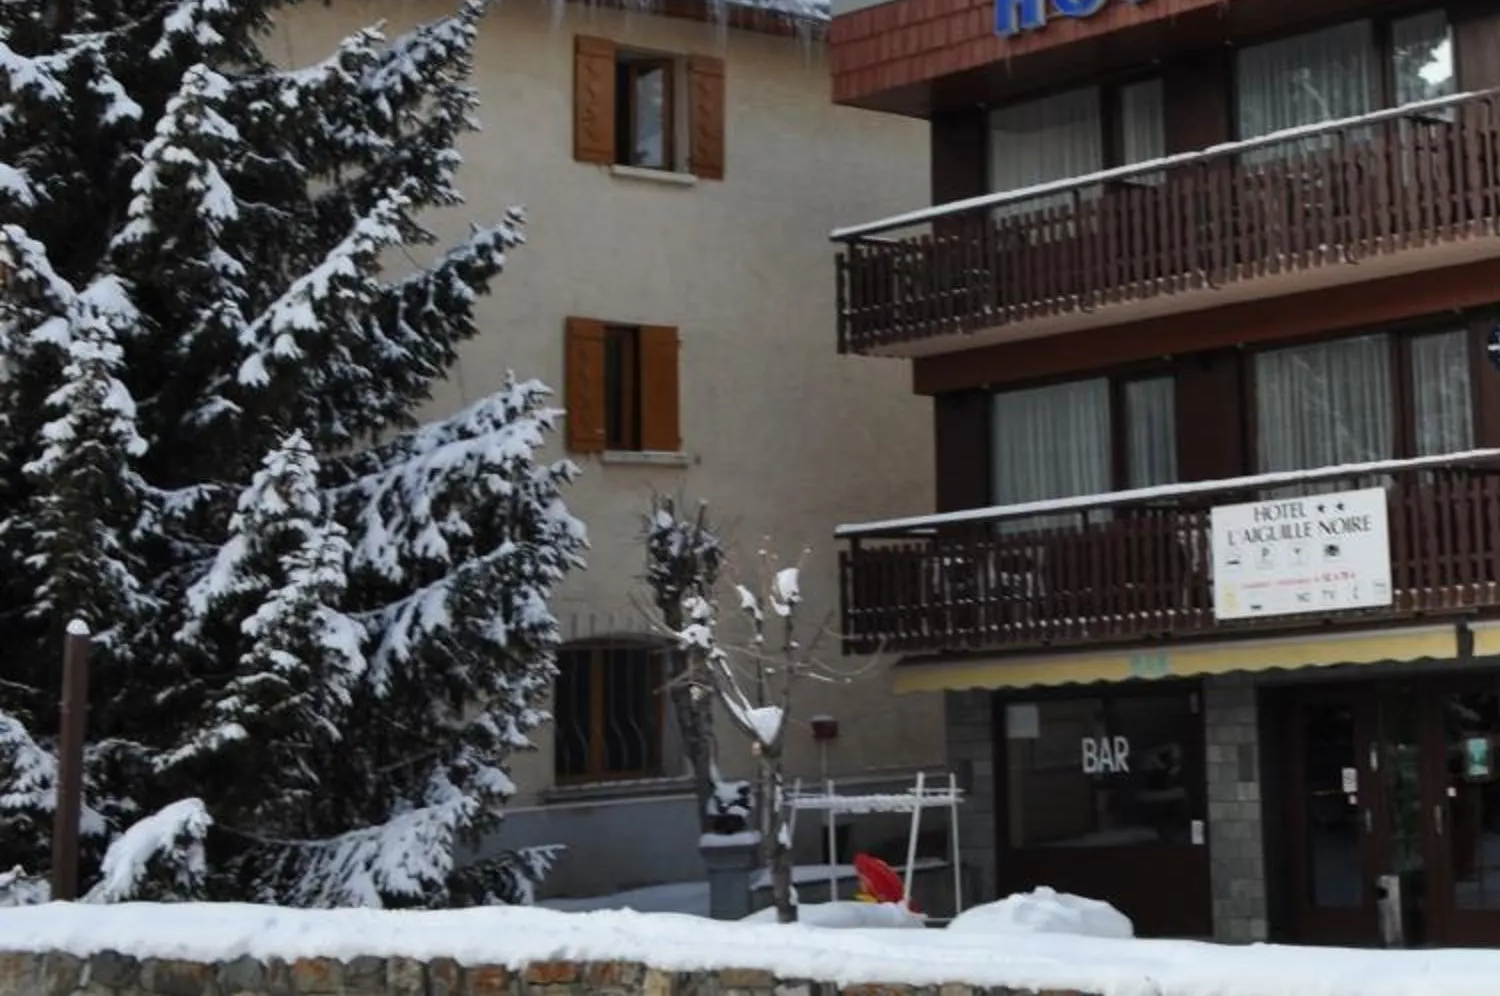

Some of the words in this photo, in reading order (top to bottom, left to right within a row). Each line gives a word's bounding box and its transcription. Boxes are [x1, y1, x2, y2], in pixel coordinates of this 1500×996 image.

[1253, 502, 1309, 523] HOTEL
[1318, 515, 1373, 535] NOIRE
[1081, 735, 1130, 773] BAR
